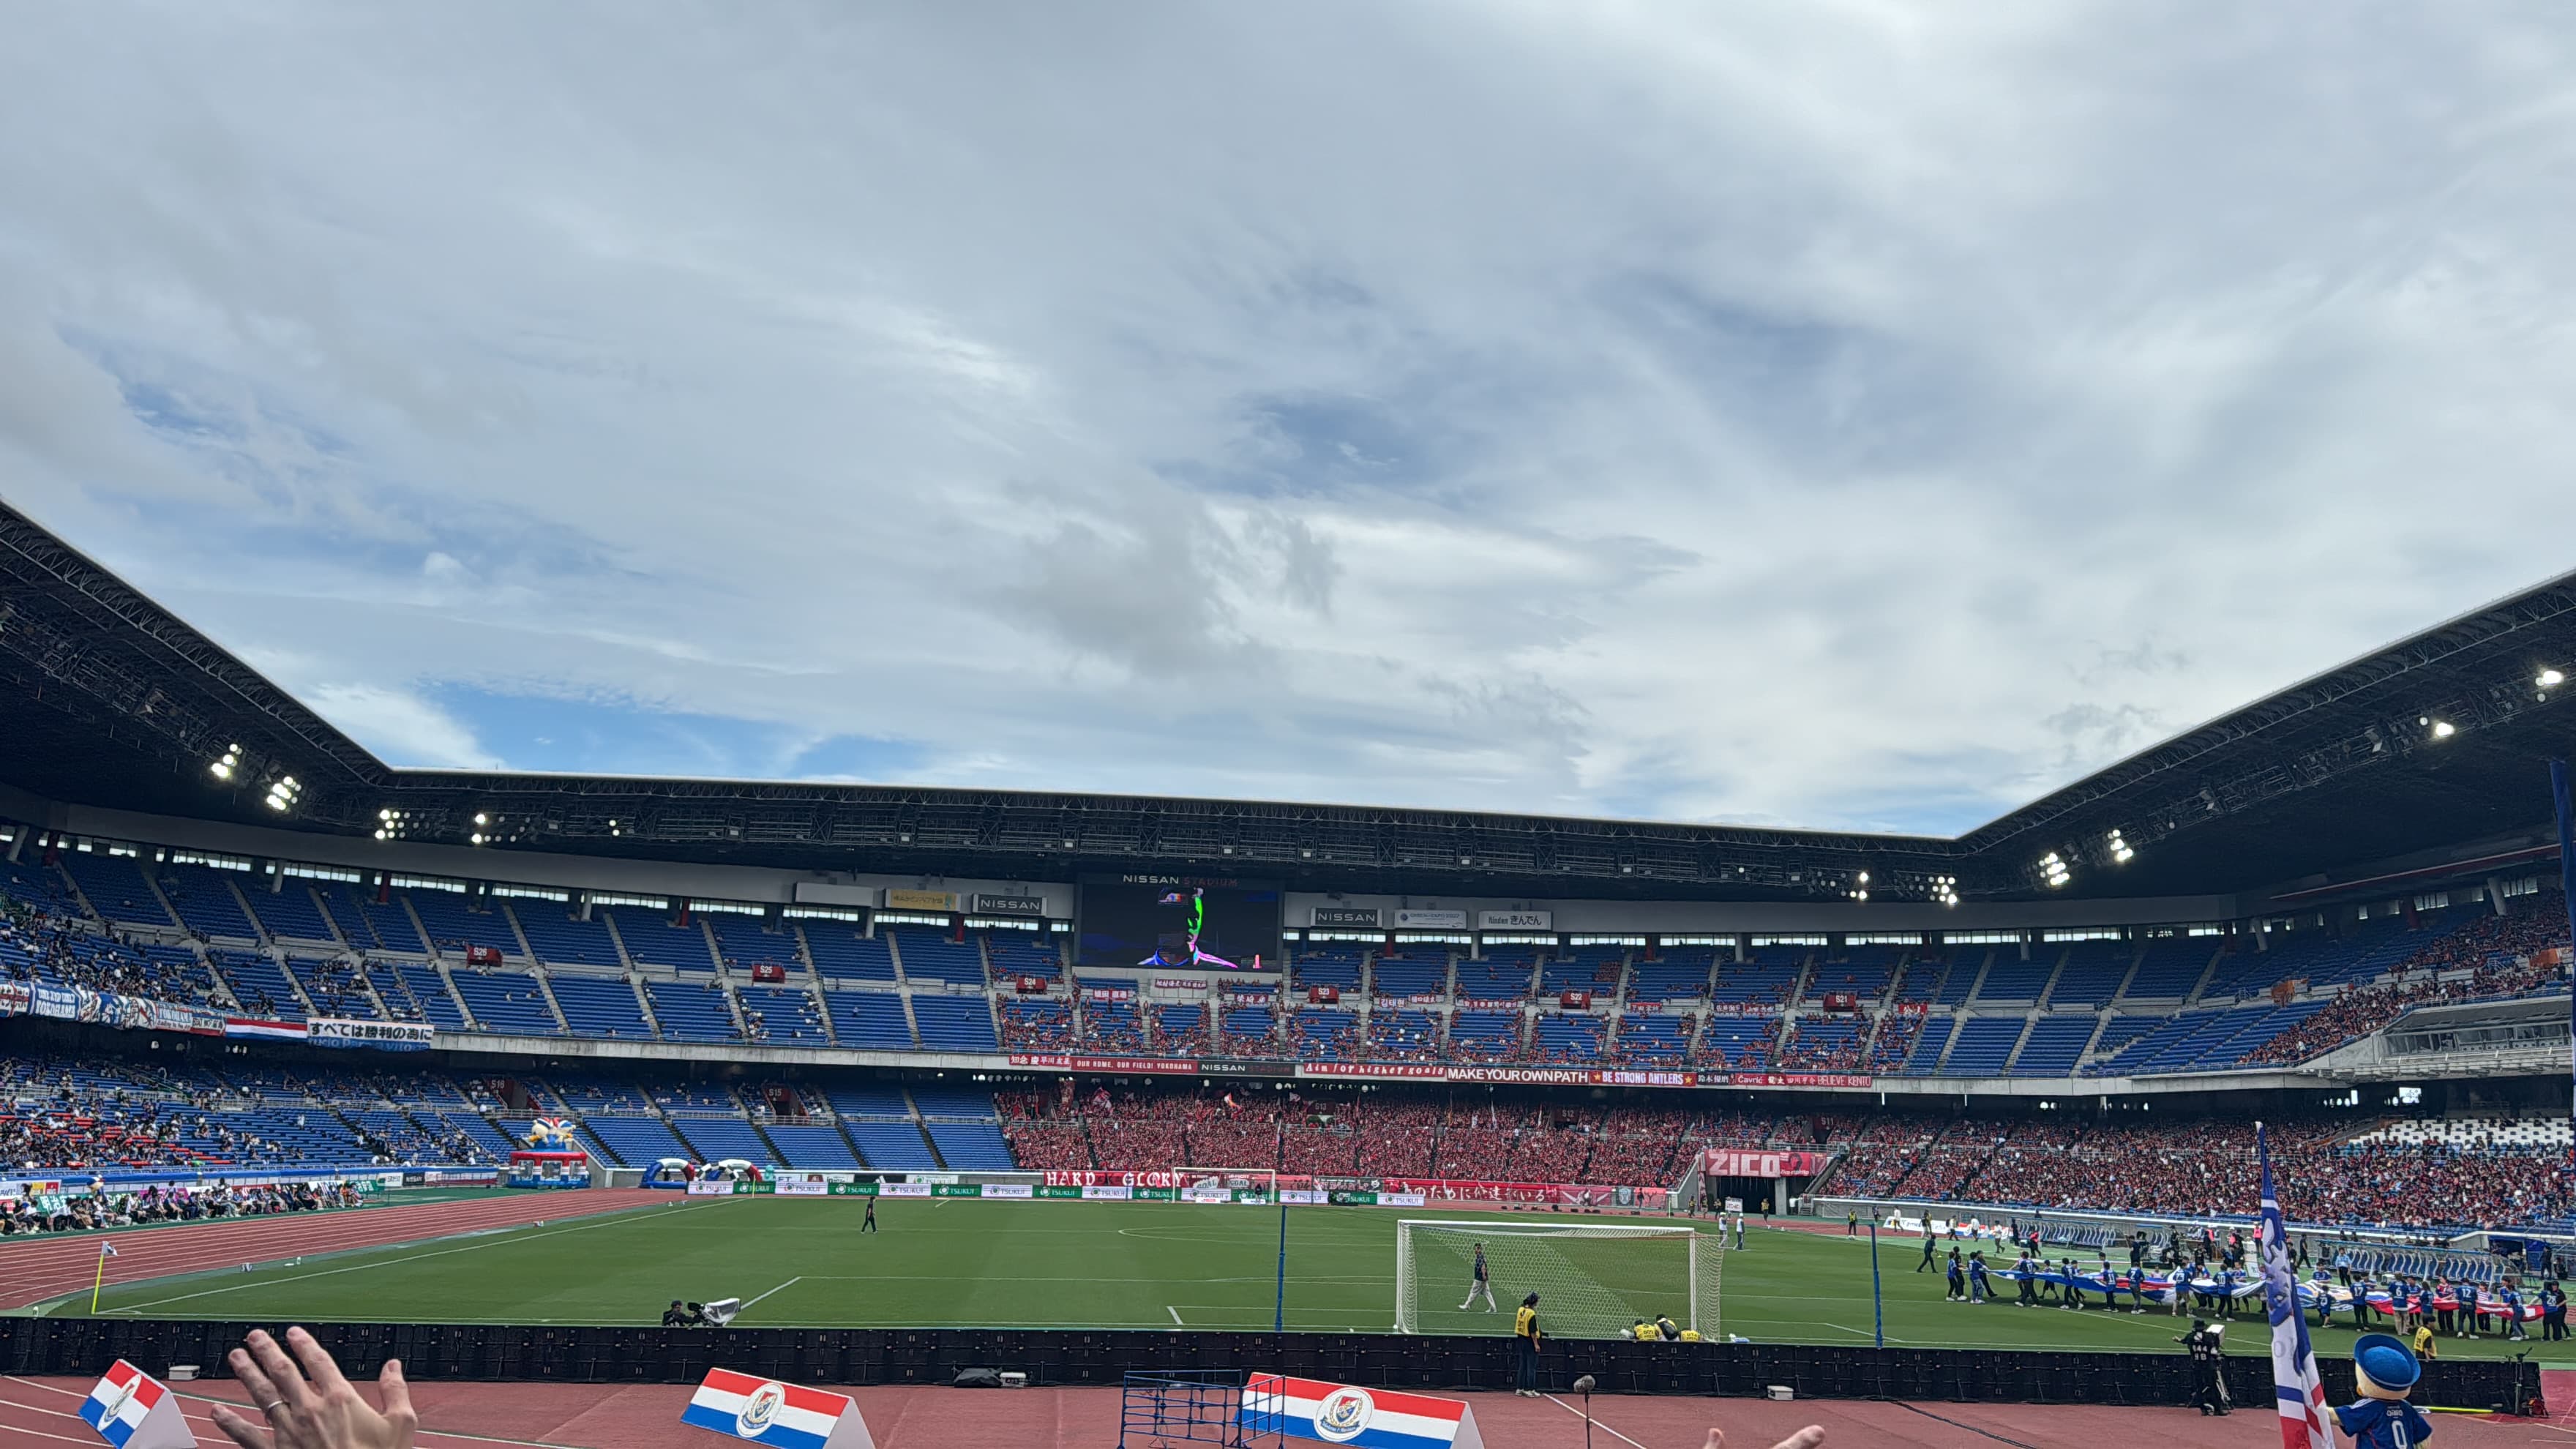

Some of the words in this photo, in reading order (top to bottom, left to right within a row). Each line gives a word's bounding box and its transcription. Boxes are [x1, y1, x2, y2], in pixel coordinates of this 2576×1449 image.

[1123, 875, 1179, 885] NISSAN
[1183, 878, 1238, 888] STADIUM
[981, 899, 1040, 910] NISSAN
[1318, 913, 1375, 922] NISSAN
[1510, 915, 1542, 925] きんでん
[473, 947, 487, 956] S26
[760, 965, 773, 974] S25
[1025, 978, 1036, 986] S24
[1835, 995, 1848, 1003] S21
[310, 1022, 433, 1041] すべては勝利の為に
[1157, 1063, 1192, 1071] YOKOHAMA
[1201, 1063, 1246, 1072] NISSAN
[1248, 1065, 1290, 1073] STADIUM
[1306, 1063, 1328, 1072] Aim
[1333, 1063, 1354, 1074] for
[1359, 1065, 1403, 1075] higher
[1408, 1066, 1444, 1076] goals
[1448, 1068, 1485, 1081] MAKE
[1486, 1068, 1520, 1082] YOUR
[1521, 1069, 1556, 1082] OWN
[1557, 1071, 1588, 1083] PATH
[1602, 1071, 1612, 1082] BE
[1614, 1072, 1647, 1084] STRONG
[1648, 1073, 1684, 1085] ANTLERS
[1737, 1075, 1762, 1084] Čavrić
[1818, 1075, 1846, 1086] BELIEVE
[1848, 1076, 1871, 1087] KENTO
[768, 1088, 782, 1097] S15
[1562, 1109, 1574, 1117] S12
[1709, 1153, 1781, 1177] ZICO
[1046, 1172, 1096, 1186] HARD
[1122, 1172, 1186, 1187] GLORY
[2218, 1275, 2225, 1284] 10
[2354, 1287, 2364, 1297] 17
[2396, 1286, 2402, 1296] 6
[2461, 1287, 2471, 1298] 12
